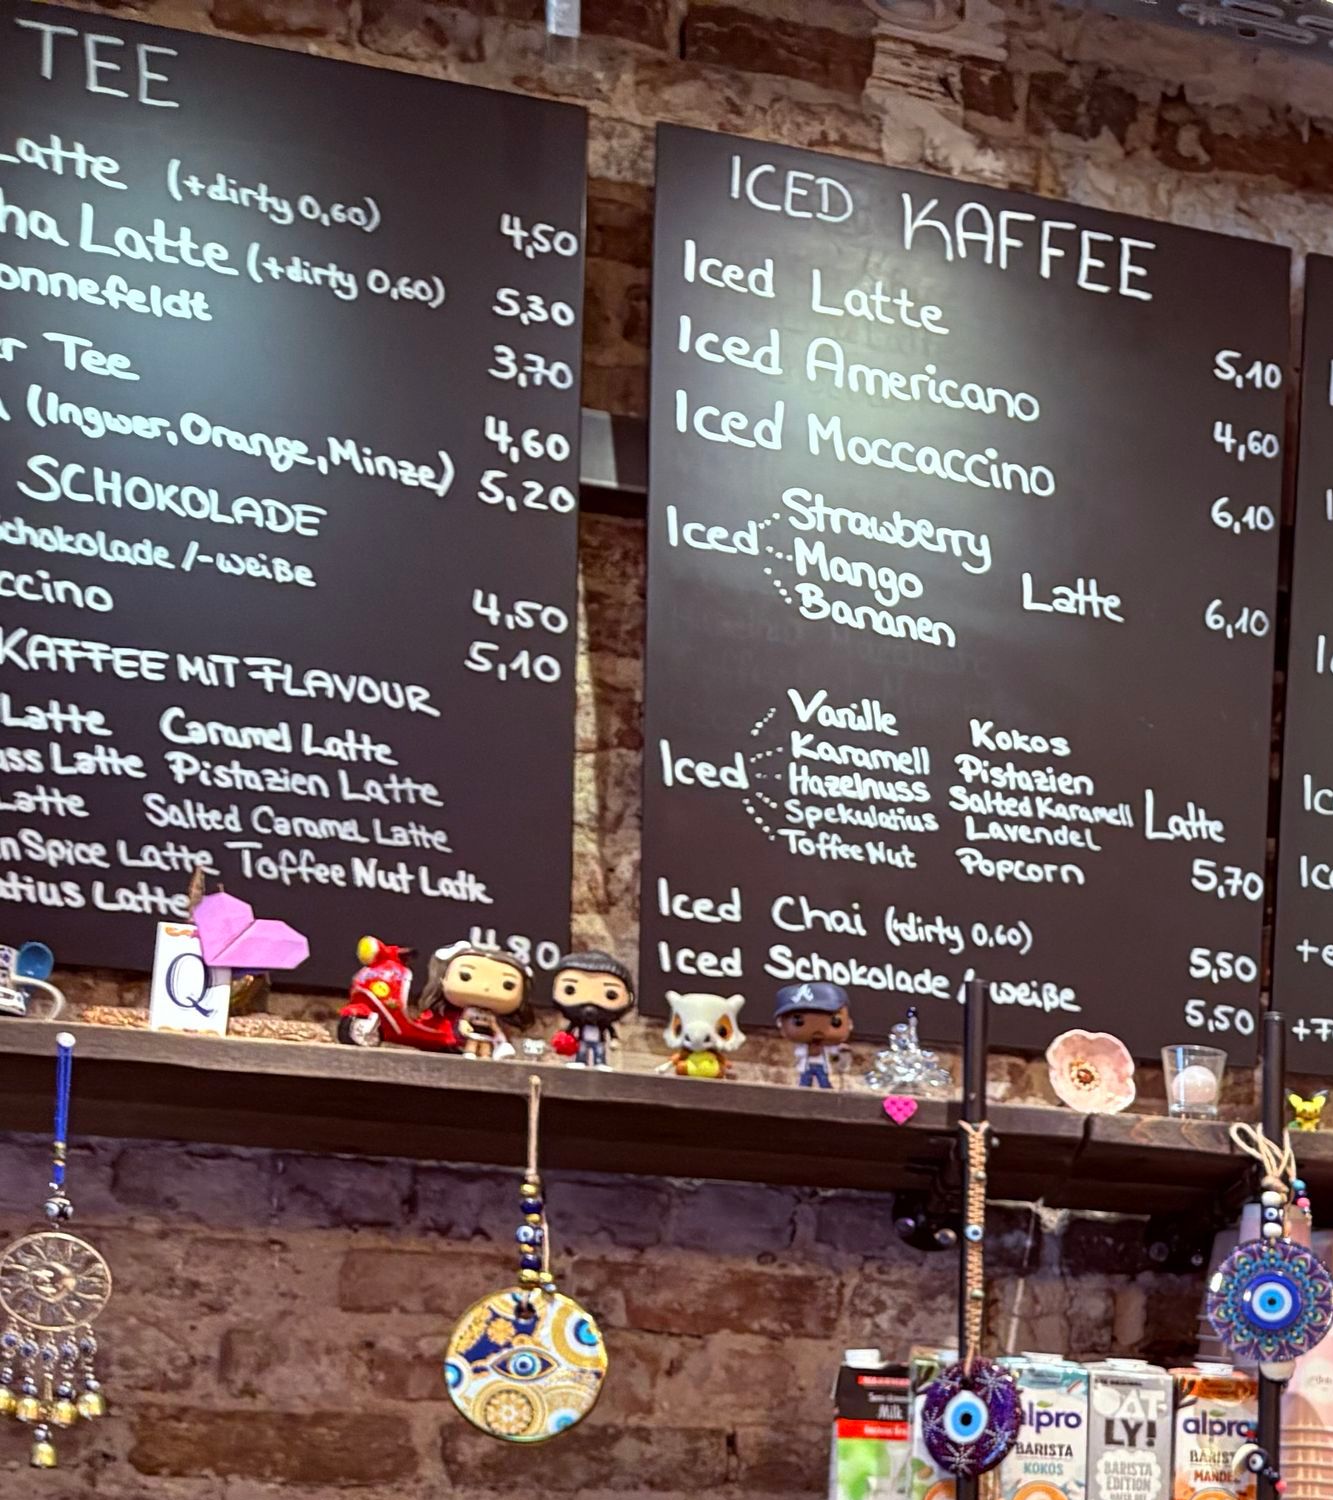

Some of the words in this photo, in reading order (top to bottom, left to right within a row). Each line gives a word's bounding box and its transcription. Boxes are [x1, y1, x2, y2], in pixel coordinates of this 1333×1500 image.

[15, 18, 179, 108] TEE
[501, 214, 578, 259] 4,50
[729, 155, 853, 224] ICED
[901, 192, 1156, 302] KAFFEE
[80, 202, 239, 276] Latte
[492, 288, 576, 327] 5,30
[683, 238, 775, 300] Iced
[811, 268, 950, 336] Latte
[1213, 349, 1283, 391] 5,10
[42, 332, 140, 380] Tee
[485, 415, 570, 462] 4,60
[488, 345, 573, 390] 3,70
[678, 315, 783, 377] Iced
[806, 336, 1041, 424] Americano
[1213, 420, 1281, 462] 4,60
[17, 454, 327, 537] SCHOKOLADE
[478, 469, 575, 513] 5,20
[674, 389, 784, 452] Iced
[807, 413, 1056, 499] Moccaccino
[1210, 496, 1275, 535] 6,10
[781, 487, 993, 575] Strawberry
[666, 504, 759, 556] Iced
[793, 536, 925, 607] Mango
[1021, 572, 1126, 625] Latte
[1205, 598, 1271, 639] 6,10
[472, 588, 569, 635] 4,50
[794, 582, 957, 649] Bananen
[0, 626, 170, 681] KAFFEE
[243, 657, 441, 717] FLAVOUR
[465, 640, 562, 683] 5,10
[302, 723, 400, 766] Latte
[787, 689, 900, 737] Vanille
[969, 718, 1071, 758] Kokos
[49, 741, 147, 779] Latte
[164, 751, 330, 799] Pistazien
[338, 769, 444, 807] Latte
[660, 738, 749, 790] Iced
[788, 762, 932, 804] Hazelnuss
[948, 785, 1034, 819] Salted
[1036, 796, 1134, 830] Karamell
[1144, 789, 1227, 845] Latte
[791, 731, 931, 777] Karamell
[953, 753, 1095, 798] Pistazien
[143, 793, 243, 833] Salted
[372, 818, 454, 853] Latte
[784, 799, 940, 833] Spekulatius
[116, 839, 221, 876] Latte
[224, 841, 347, 886] Toffee
[350, 857, 414, 894] Nut
[955, 847, 1085, 886] Popcorn
[1190, 858, 1265, 902] 5,70
[657, 877, 742, 925] Iced
[771, 895, 868, 938] Chai
[1189, 947, 1259, 985] 5,50
[658, 941, 743, 979] Iced
[764, 944, 951, 1000] Schokolade
[1184, 999, 1256, 1036] 5,50
[1016, 1442, 1073, 1457] BARISTA
[1022, 1404, 1083, 1434] lpro
[1024, 1462, 1064, 1475] KOKOS
[1190, 1450, 1235, 1465] BARIST
